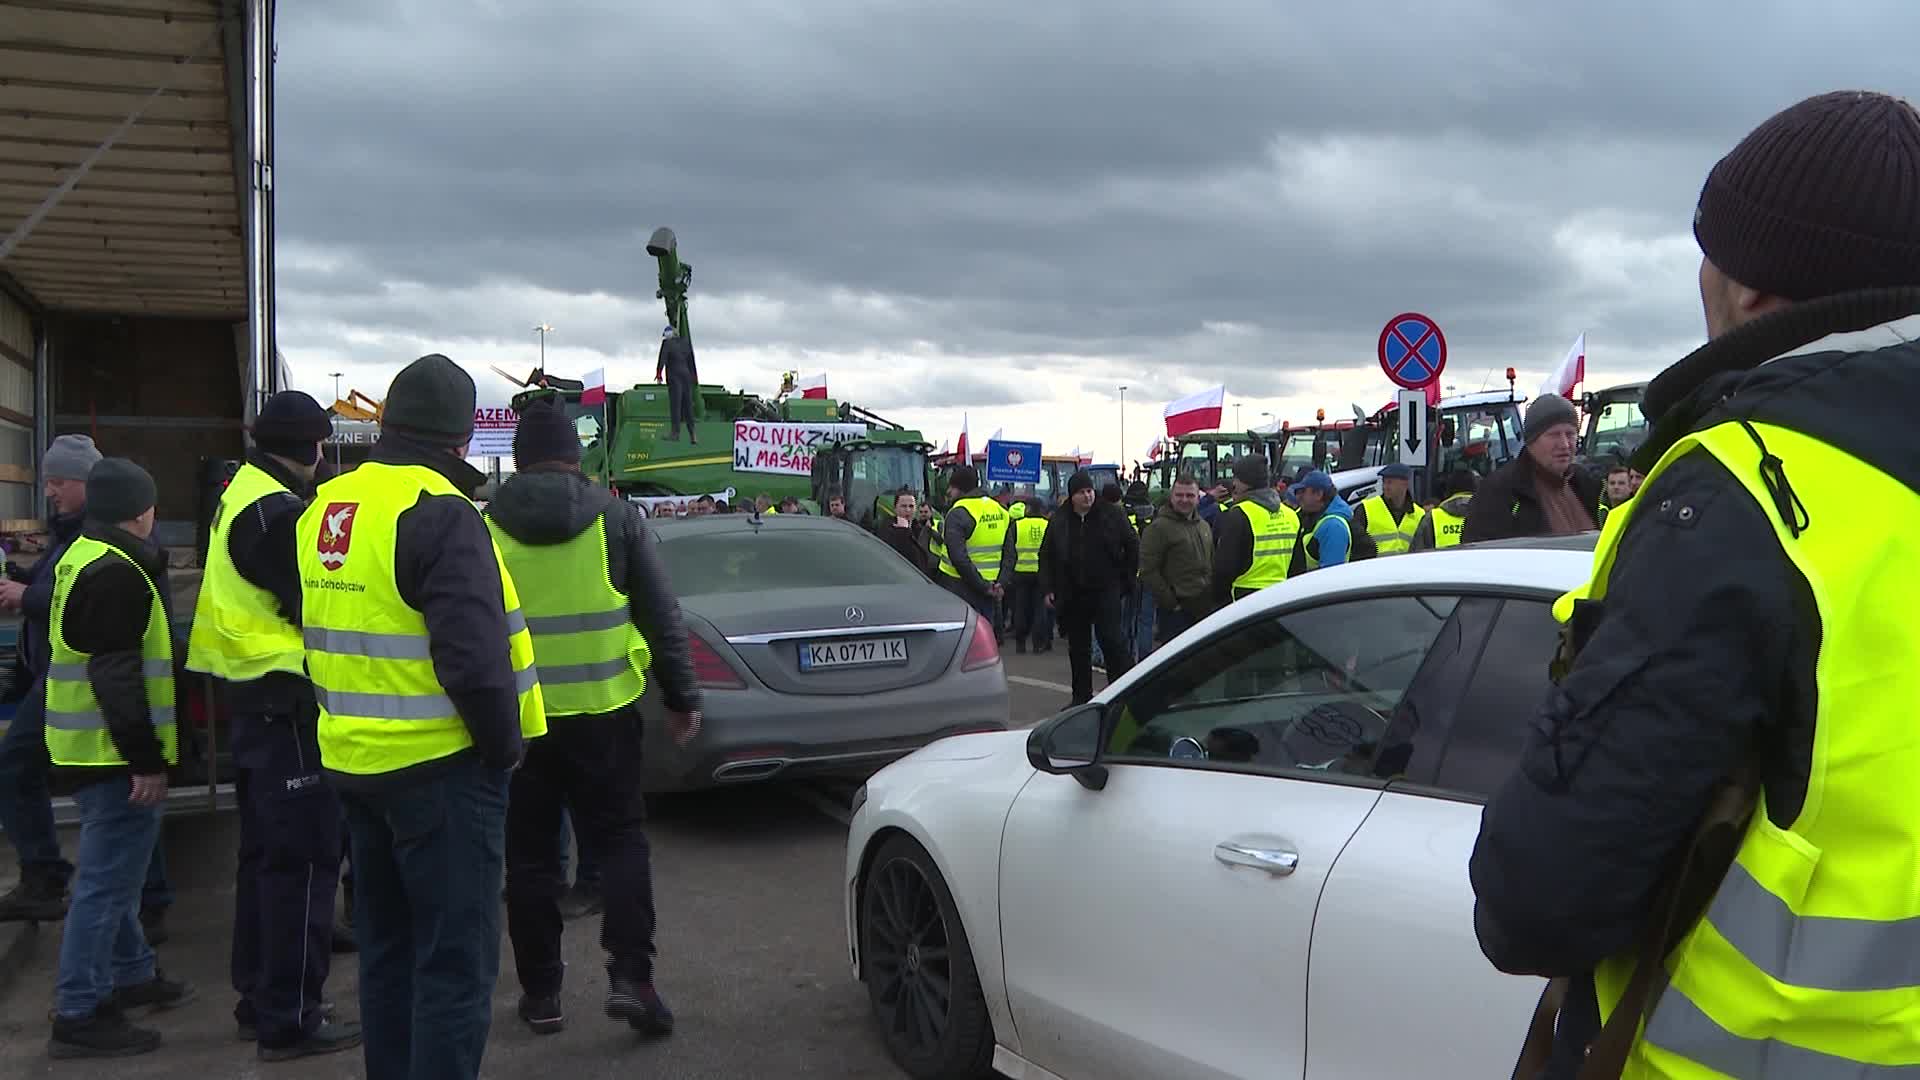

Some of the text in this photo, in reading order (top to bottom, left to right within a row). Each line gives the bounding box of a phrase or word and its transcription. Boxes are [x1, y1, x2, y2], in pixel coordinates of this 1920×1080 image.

[735, 424, 805, 446] ROLNIK
[811, 640, 903, 665] KA 0717 IK
